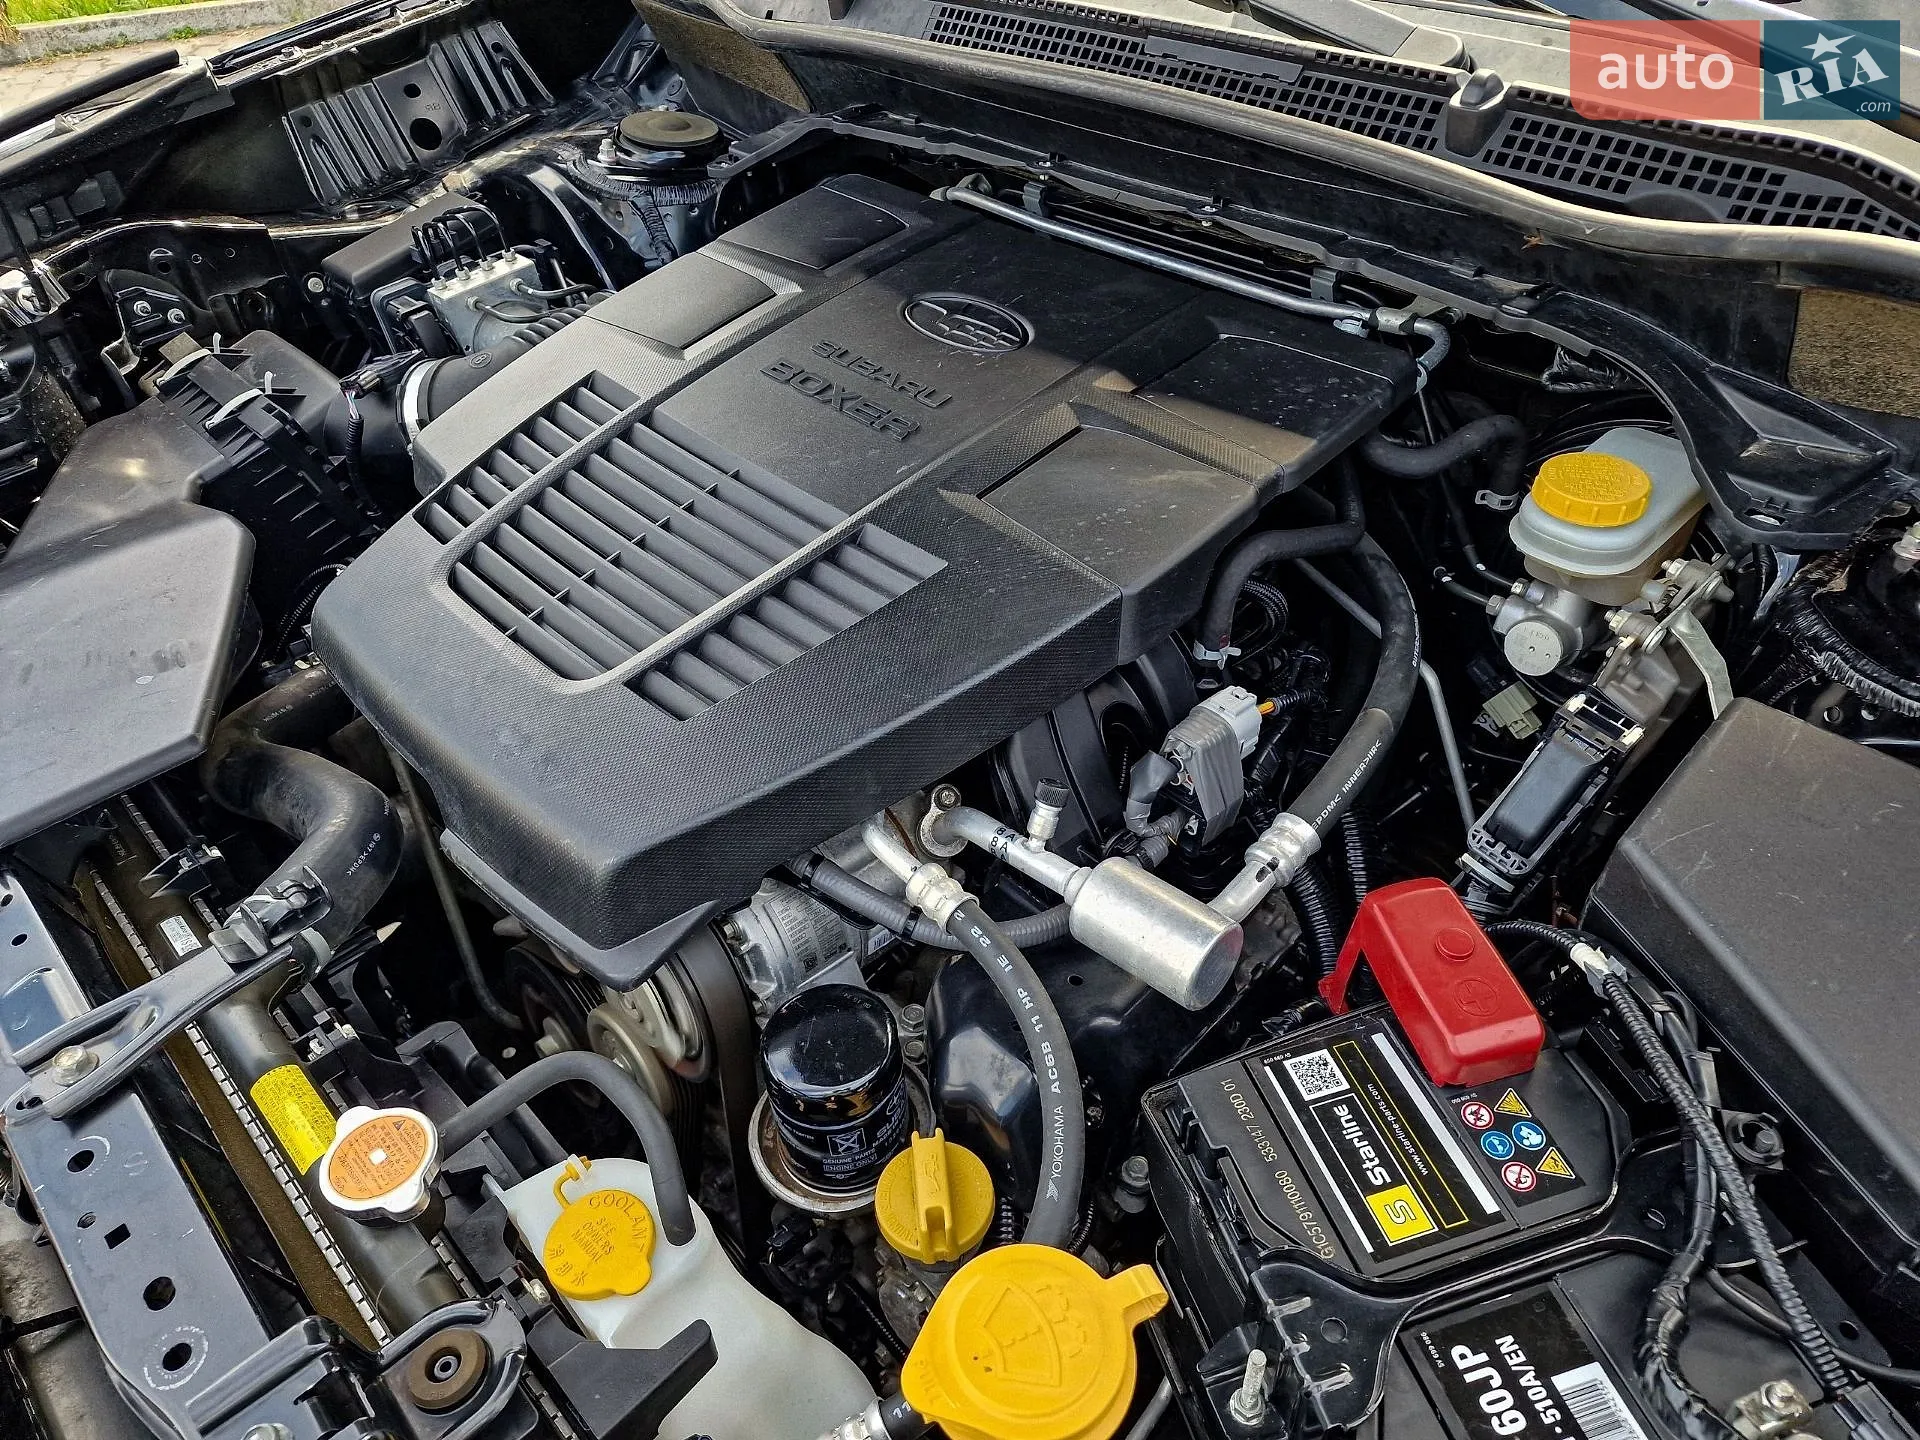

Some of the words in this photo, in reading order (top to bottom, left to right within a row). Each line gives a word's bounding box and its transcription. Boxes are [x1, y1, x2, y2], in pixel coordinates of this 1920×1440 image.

[760, 357, 920, 442] BOXER
[810, 339, 953, 409] SUBARU
[1016, 987, 1034, 1009] HP
[1220, 1078, 1236, 1092] 01
[1229, 1093, 1255, 1121] 230D
[855, 1148, 876, 1160] PARTS
[1051, 1105, 1064, 1179] YOKOHAMA
[1246, 1125, 1278, 1163] 533147
[1333, 1104, 1392, 1186] Starline
[1367, 1083, 1429, 1176] www.starline-parts.com
[824, 1163, 854, 1172] ENGINE
[856, 1155, 876, 1167] ONLY
[589, 1193, 648, 1253] COOLANT
[1450, 1343, 1527, 1436] 60JP
[1495, 1334, 1562, 1424] 510A/EN
